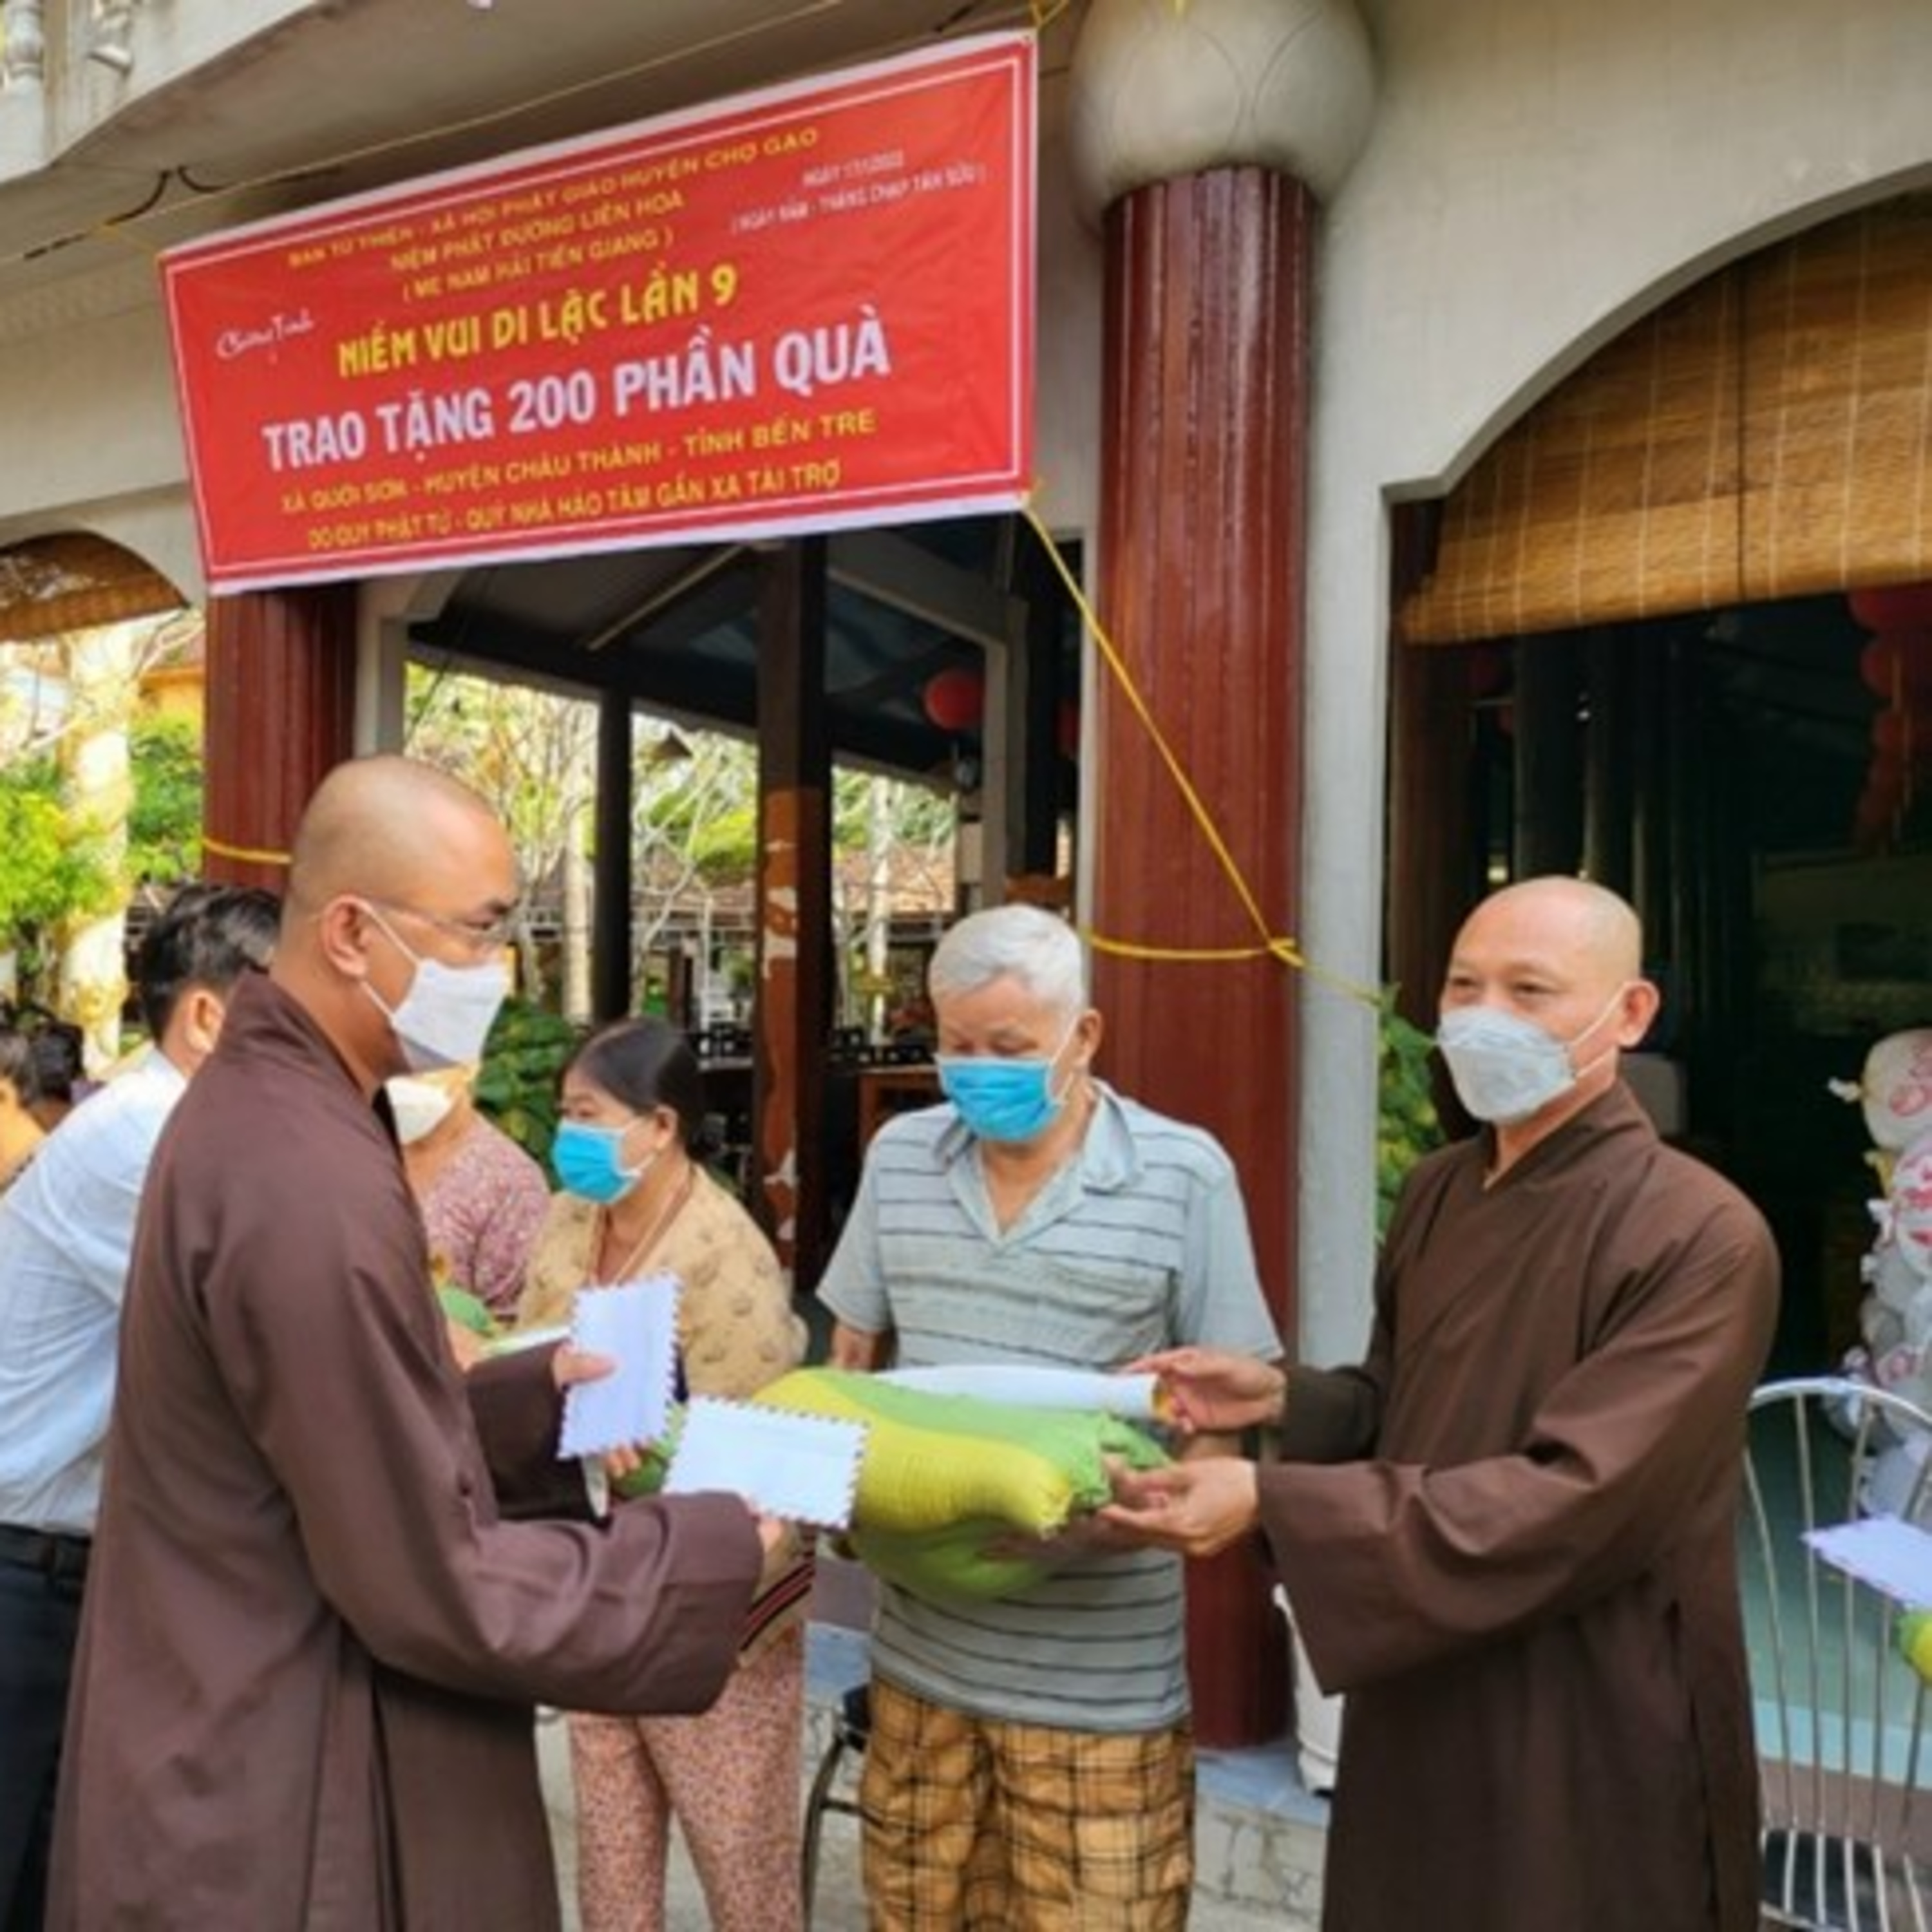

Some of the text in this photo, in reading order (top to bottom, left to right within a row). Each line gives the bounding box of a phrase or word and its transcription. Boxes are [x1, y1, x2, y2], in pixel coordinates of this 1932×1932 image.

[636, 190, 684, 215] HOA
[588, 229, 658, 260] GIANG
[338, 260, 737, 376] NIỀM VUI DI LẶC LẦN 9
[263, 303, 889, 469] TRAO TẶNG 200 PHẦN QUÀ
[505, 453, 571, 482] CHÂU
[577, 442, 661, 470] THÀNH
[684, 428, 744, 455] TỈNH
[752, 415, 810, 448] BẾN
[820, 408, 874, 436] TRE
